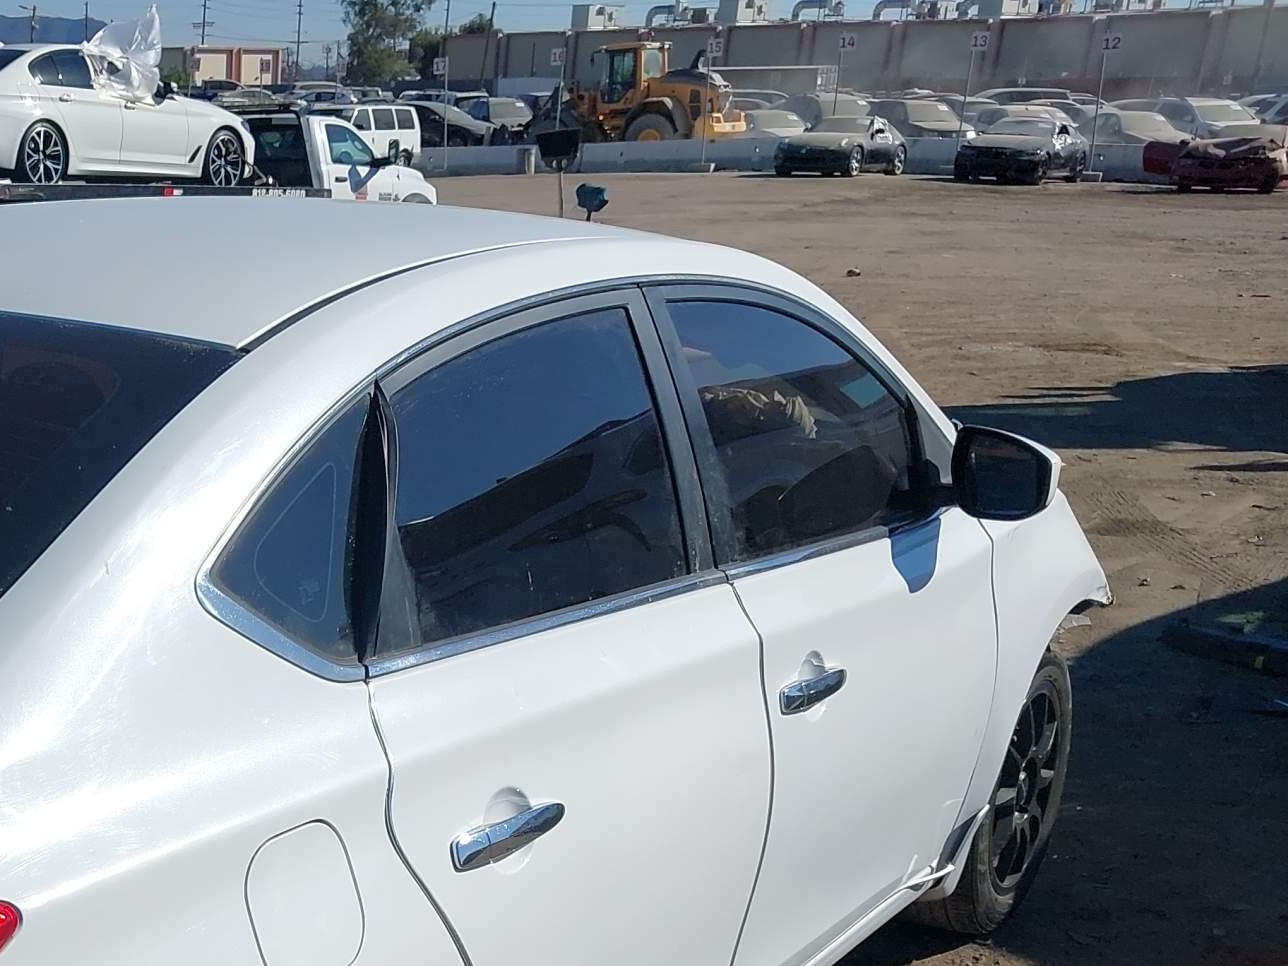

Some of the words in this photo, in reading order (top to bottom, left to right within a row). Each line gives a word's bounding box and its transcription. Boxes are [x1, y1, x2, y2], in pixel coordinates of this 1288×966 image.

[708, 41, 722, 54] 15
[840, 36, 856, 48] 14
[972, 35, 988, 48] 13
[1102, 36, 1121, 50] 12
